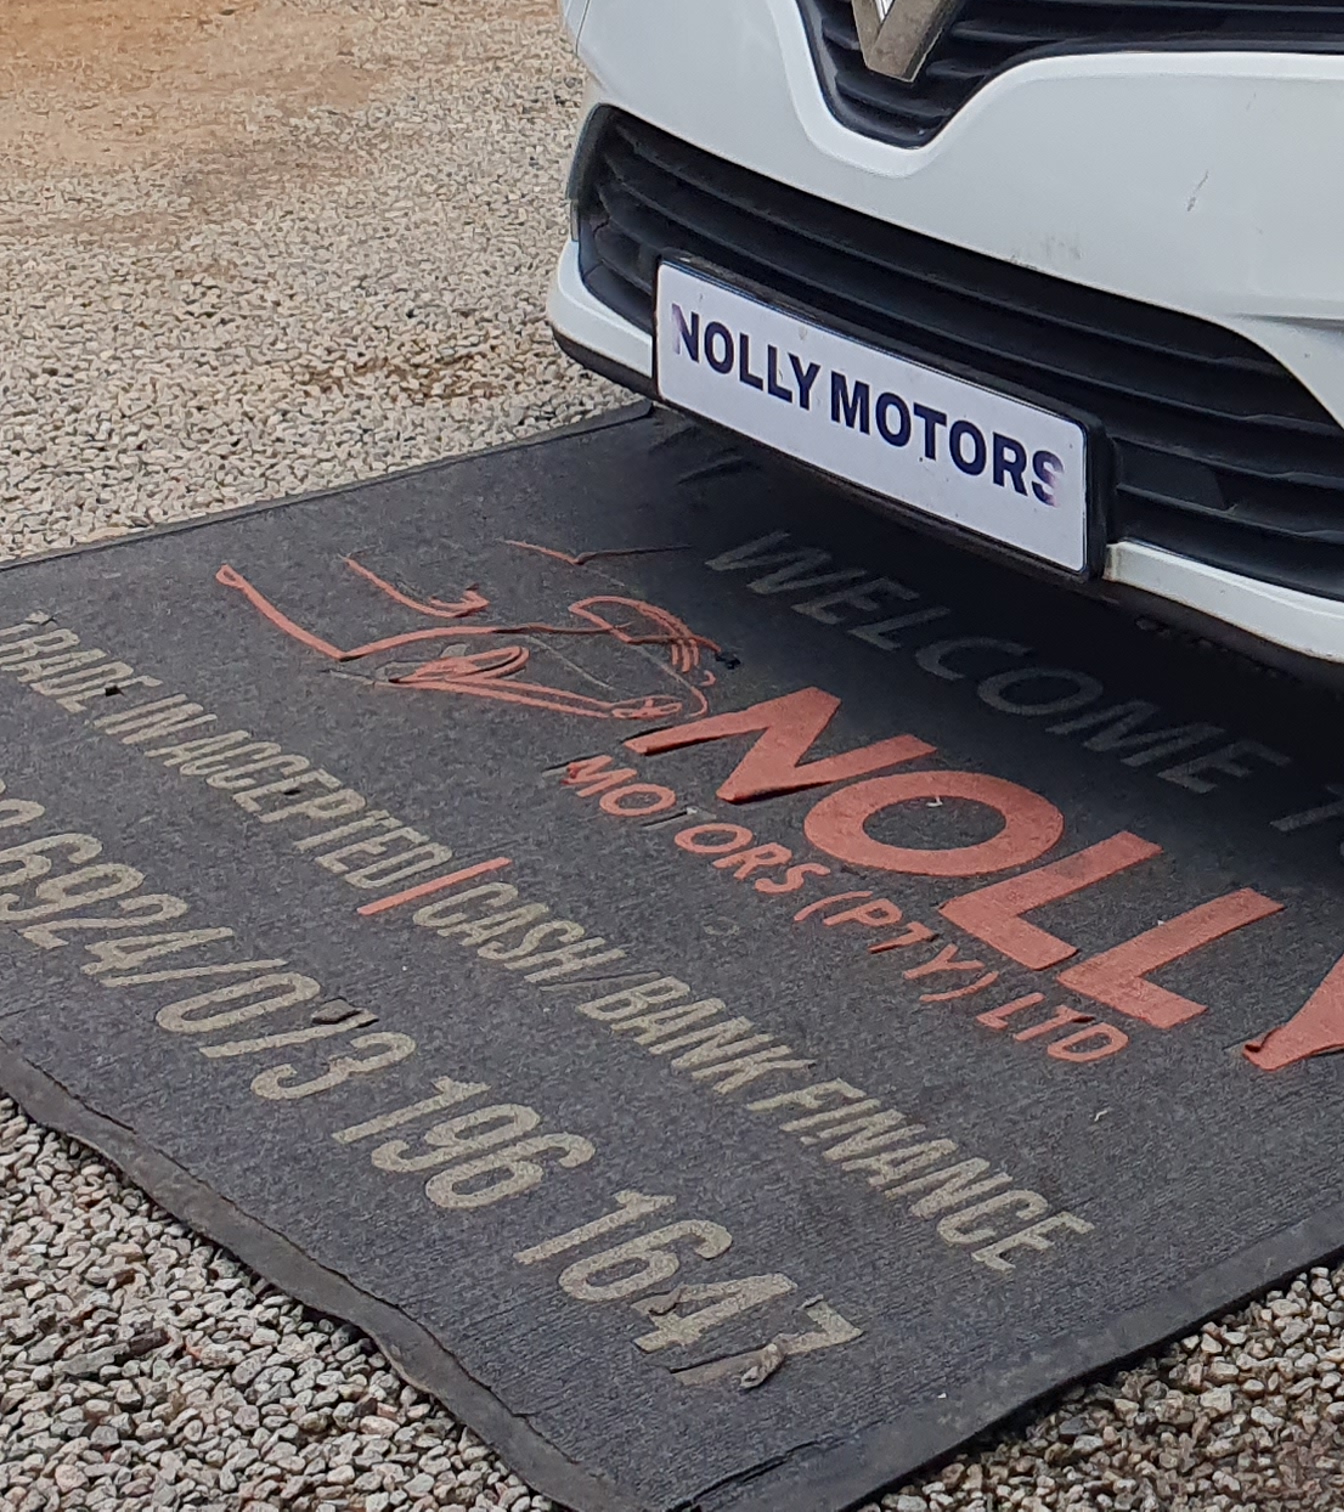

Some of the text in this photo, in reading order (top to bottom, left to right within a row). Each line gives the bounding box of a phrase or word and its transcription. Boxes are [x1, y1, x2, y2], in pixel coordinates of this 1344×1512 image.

[671, 302, 1065, 507] NOLLY MOTORS
[704, 529, 1291, 795] WELCOME
[94, 693, 218, 745] IN
[746, 1077, 1096, 1271] FINANCE
[331, 1075, 596, 1209] 196
[513, 1190, 864, 1388] 1647
